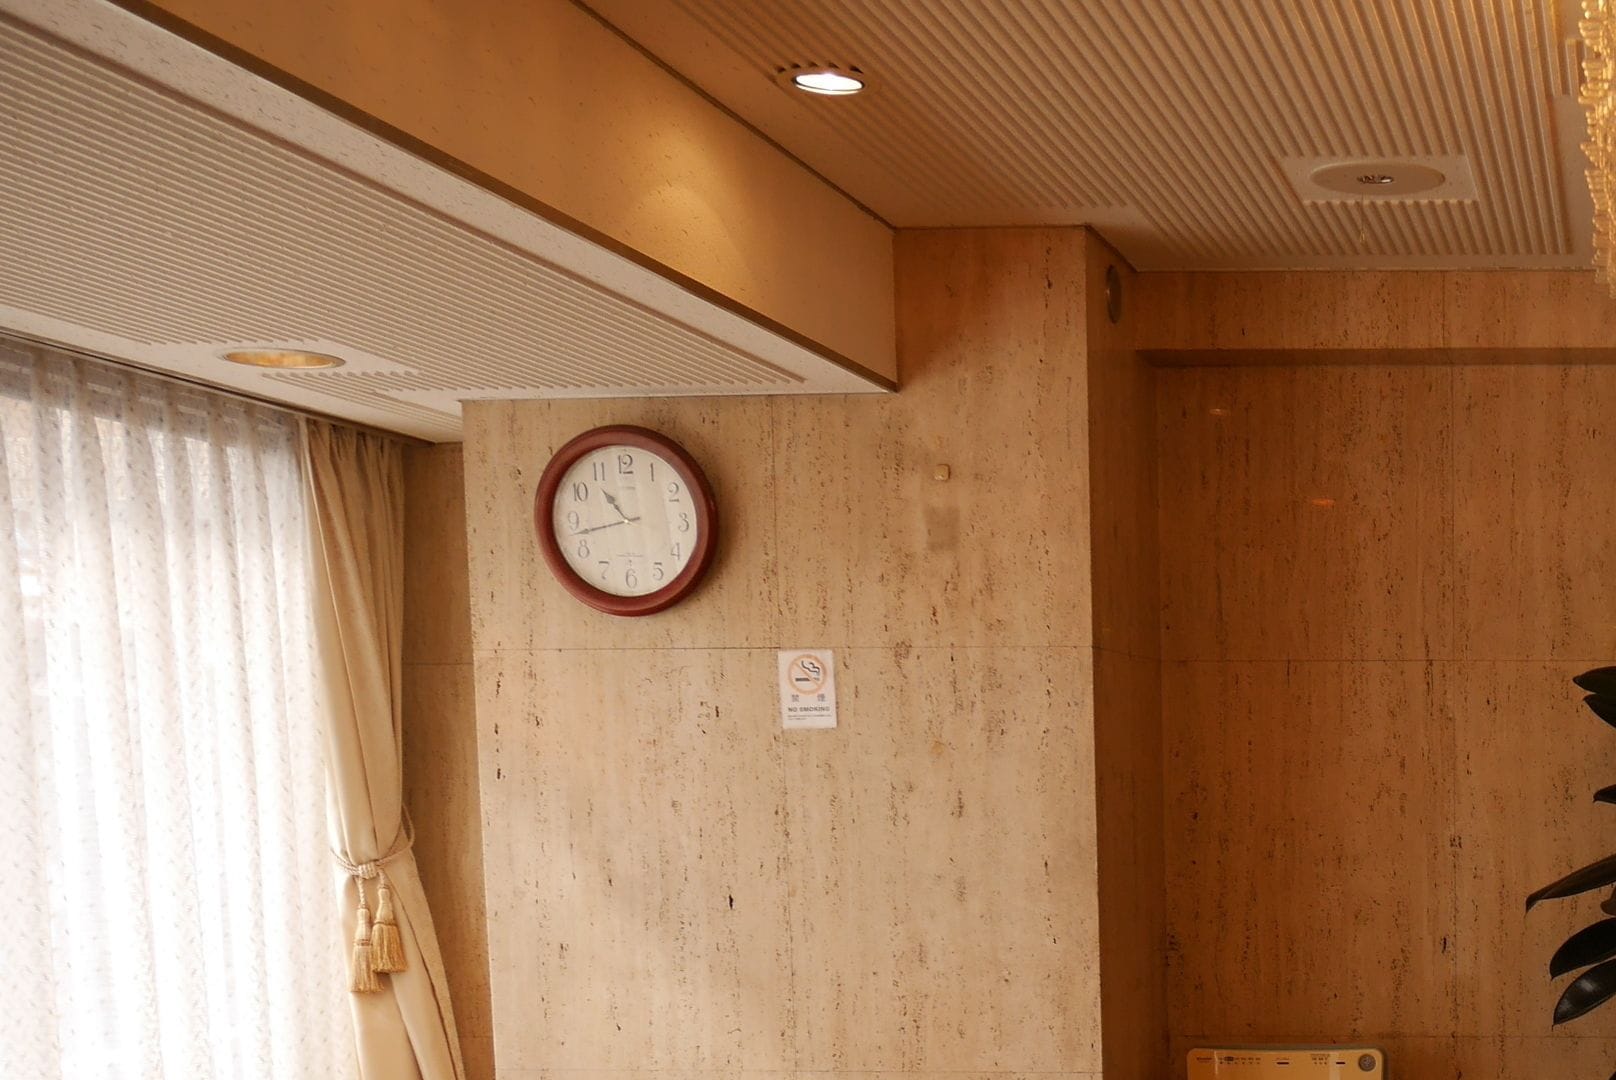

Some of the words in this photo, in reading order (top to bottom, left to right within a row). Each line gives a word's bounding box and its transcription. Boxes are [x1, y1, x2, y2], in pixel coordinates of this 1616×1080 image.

[593, 462, 606, 481] 11
[618, 454, 634, 474] 12
[650, 462, 655, 482] 1
[573, 482, 588, 502] 10
[668, 482, 680, 502] 2
[568, 511, 580, 531] 9
[678, 513, 690, 532] 3
[577, 539, 590, 559] 8
[670, 542, 681, 561] 4
[598, 561, 610, 580] 7
[625, 568, 638, 589] 6
[653, 562, 664, 581] 5
